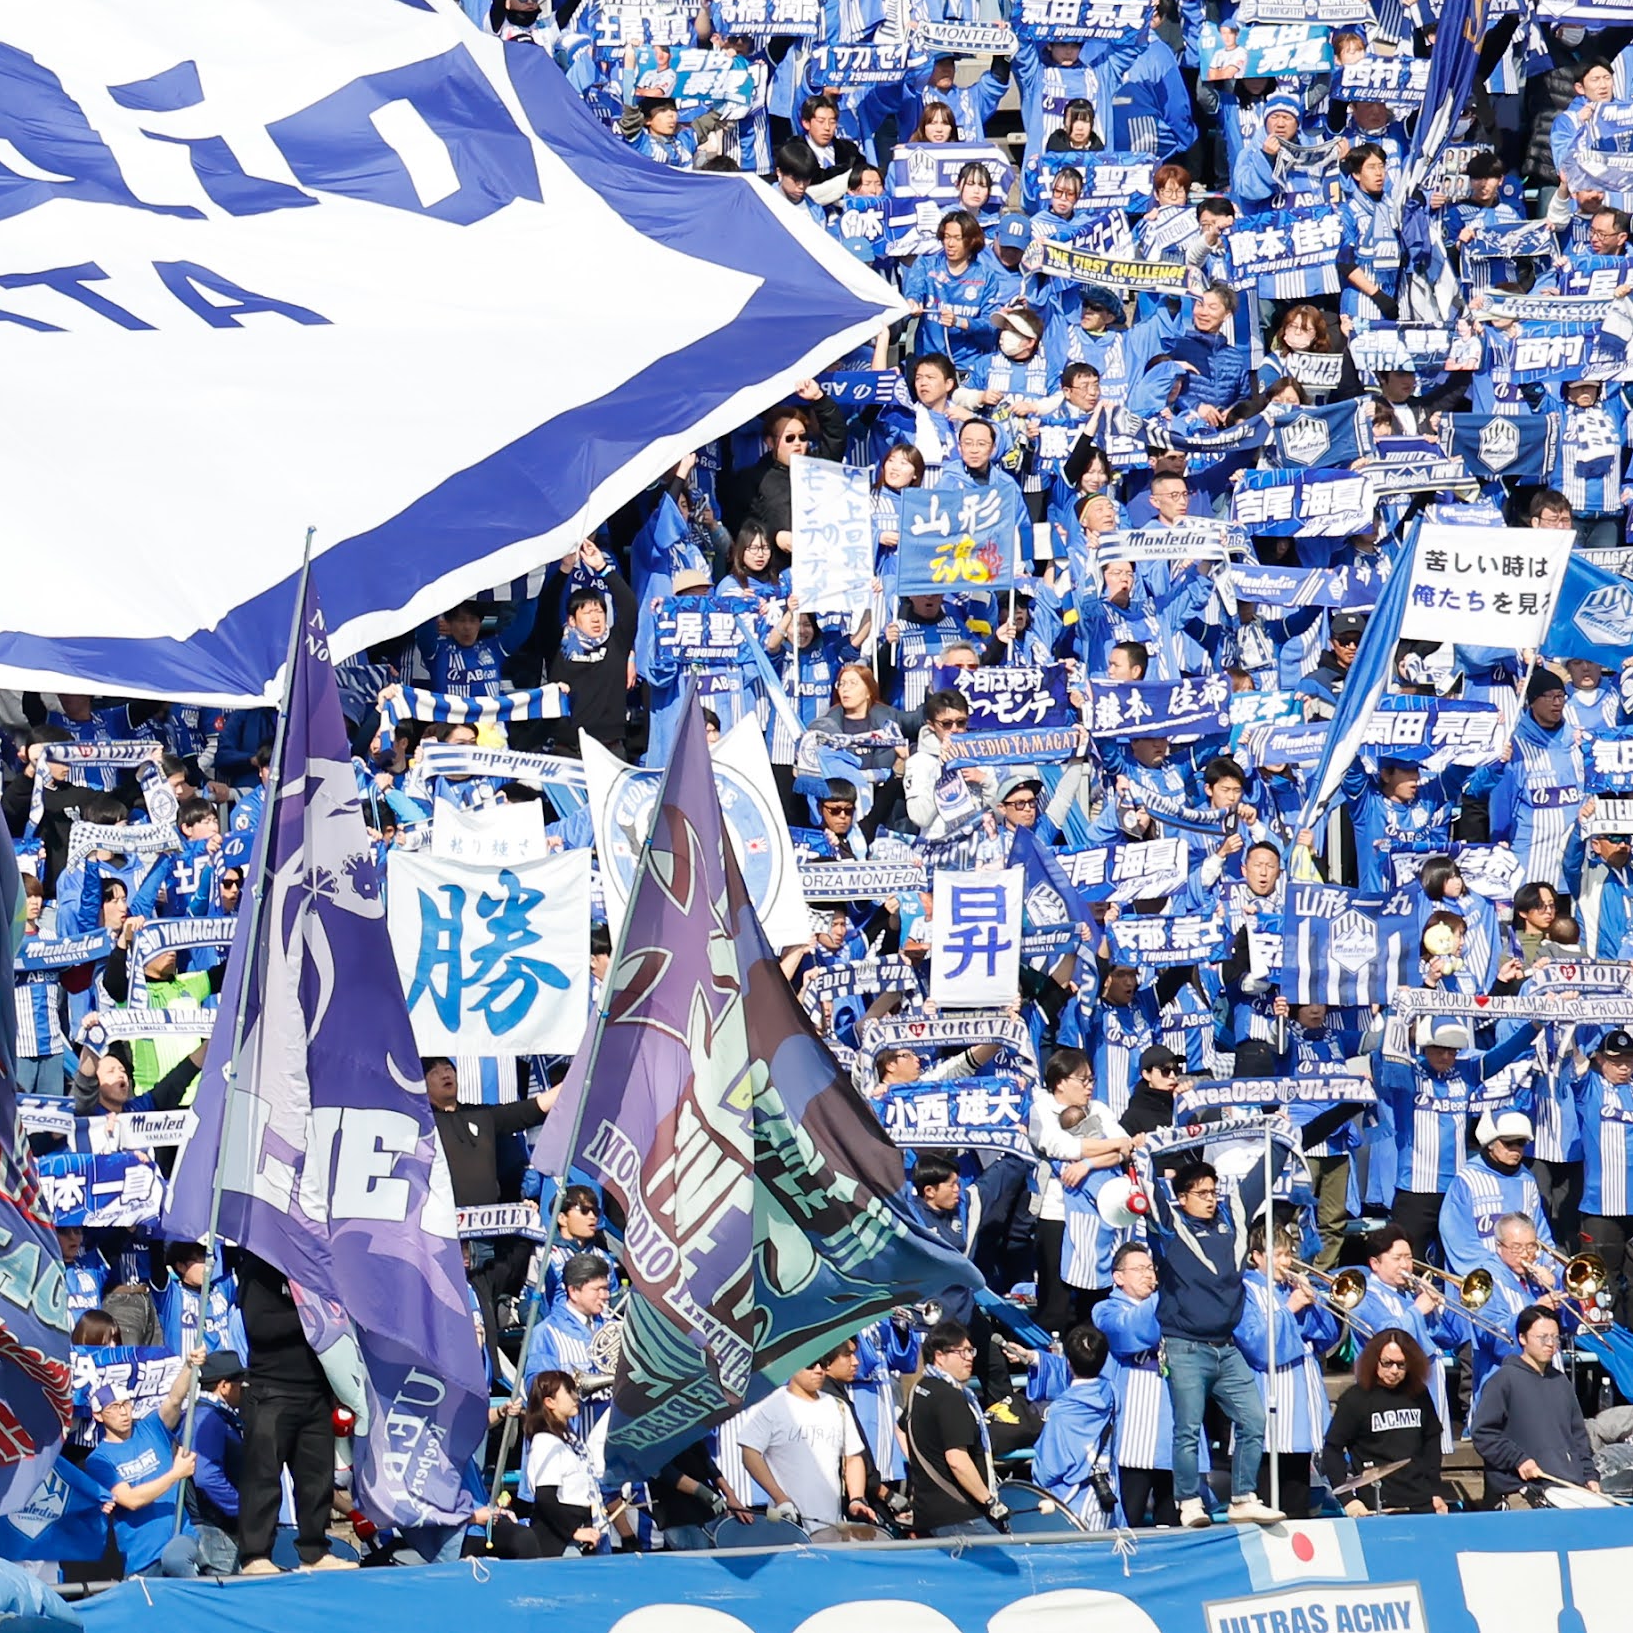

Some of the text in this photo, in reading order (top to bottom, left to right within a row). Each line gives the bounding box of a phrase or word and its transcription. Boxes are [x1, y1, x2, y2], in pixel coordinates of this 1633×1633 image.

[1047, 250, 1187, 281] THE FIRST CHALLENGE
[1237, 480, 1369, 521] 吉尾海夏
[912, 496, 1000, 537] 山形
[1126, 532, 1207, 549] Montedio
[1425, 550, 1550, 578] 苦しい時は
[1295, 892, 1412, 919] 山形一丸
[942, 884, 1012, 978] 昇
[25, 937, 102, 958] Montedio
[407, 869, 572, 1035] 勝
[1431, 994, 1508, 1012] PROUD OF
[1336, 1599, 1412, 1632] ACMY
